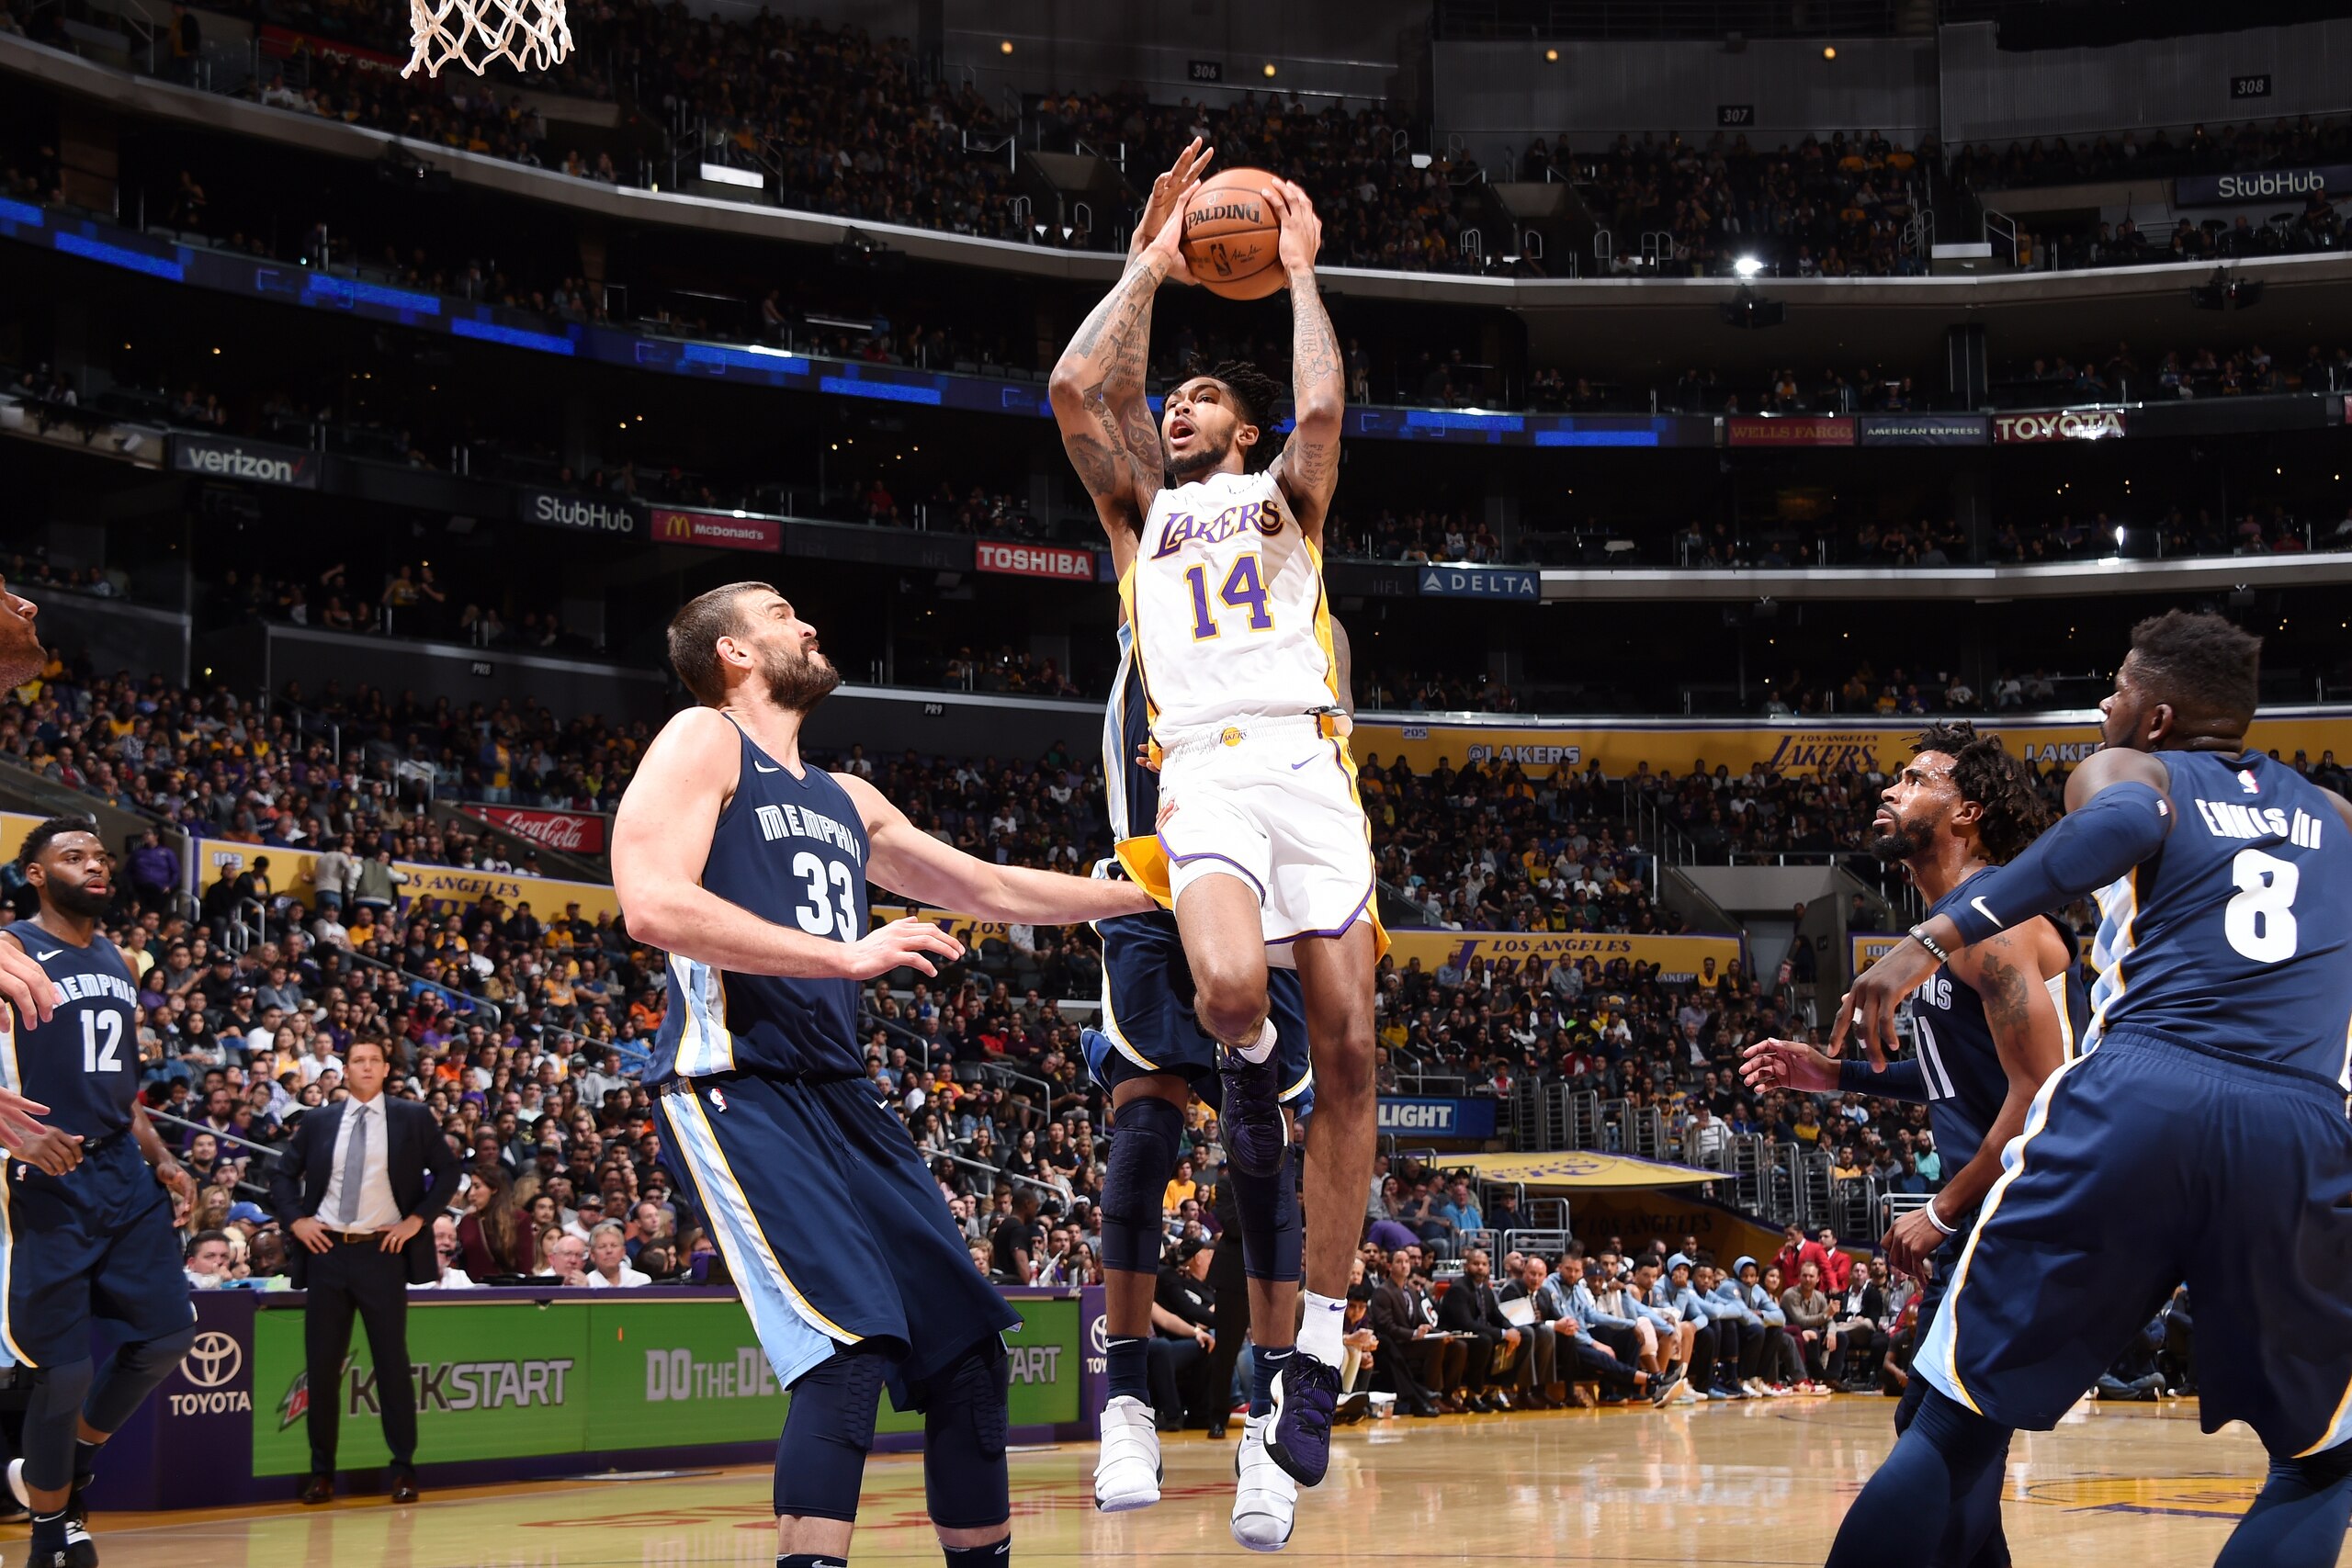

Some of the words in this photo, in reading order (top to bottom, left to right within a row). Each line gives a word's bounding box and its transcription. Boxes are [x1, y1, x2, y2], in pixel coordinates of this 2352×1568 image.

[1193, 64, 1217, 79] 306
[2238, 79, 2265, 95] 308
[1724, 109, 1748, 123] 307
[2219, 171, 2324, 197] StubHub
[1186, 203, 1261, 230] PALDING
[1732, 426, 1790, 439] WELLS
[1794, 425, 1854, 438] FARGO
[1866, 427, 1928, 435] AMERICAN
[1929, 426, 1982, 435] EXPRESS
[1996, 412, 2123, 441] TOYOTA
[189, 447, 292, 482] verizon
[537, 495, 634, 533] StubHub
[695, 524, 764, 540] McDonald's
[1149, 499, 1284, 561] LAKERS
[978, 546, 1091, 576] TOSHIBA
[1182, 551, 1275, 643] 14
[1452, 574, 1534, 594] DELTA
[1403, 728, 1427, 738] 205
[1468, 744, 1580, 764] @LAKERS
[1770, 735, 1878, 774] LAKERS
[2195, 798, 2289, 840] ENNIS
[2290, 807, 2322, 850] III
[426, 876, 521, 897] ANGELES
[792, 852, 858, 943] 33
[2224, 849, 2299, 964] 8
[1492, 940, 1530, 952] LOS
[1534, 939, 1632, 952] ANGELES
[80, 1010, 122, 1073] 12
[1912, 1016, 1956, 1100] 11
[1378, 1104, 1452, 1128] LIGHT
[169, 1391, 252, 1416] TOYOTA
